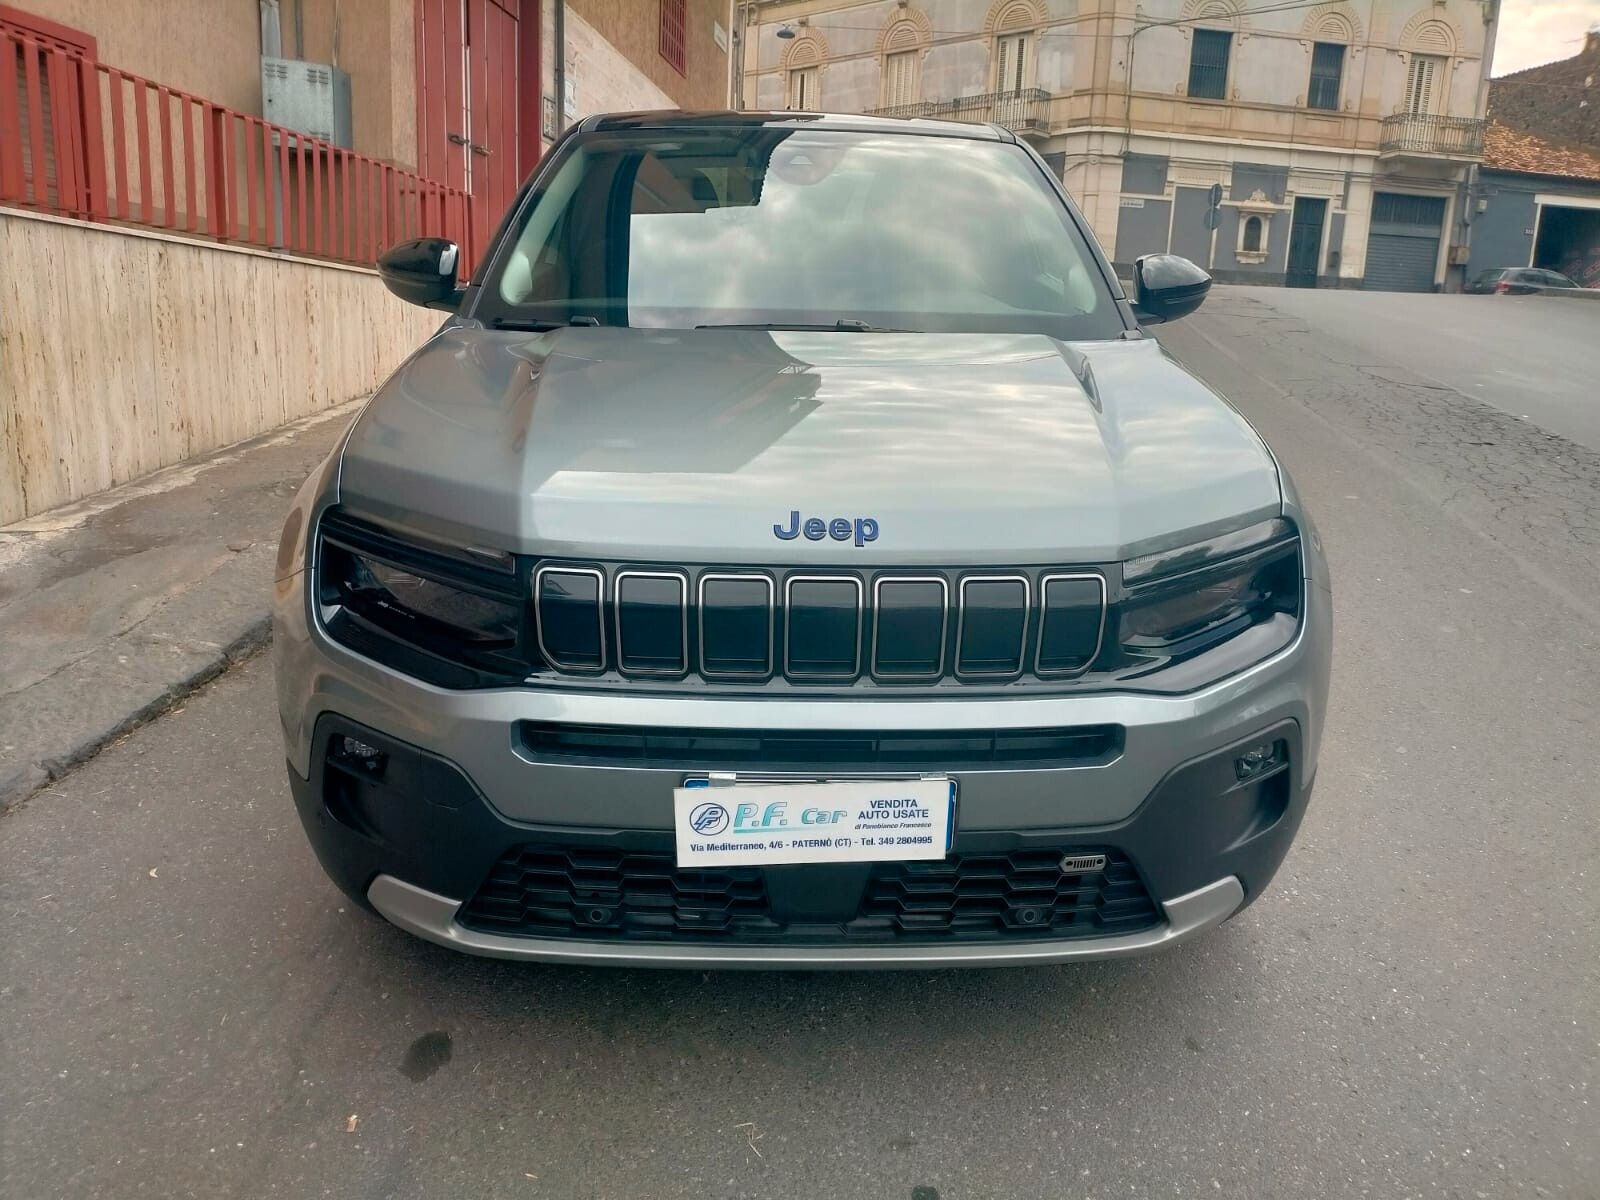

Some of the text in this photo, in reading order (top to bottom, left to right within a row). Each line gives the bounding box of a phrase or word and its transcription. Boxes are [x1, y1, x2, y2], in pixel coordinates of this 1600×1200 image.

[773, 510, 880, 547] Jeep
[869, 800, 918, 809] VENDITA
[734, 801, 848, 828] P.F. Car
[858, 809, 929, 819] AUTO USATE
[690, 843, 704, 852] Via
[769, 841, 783, 849] 4/6
[835, 839, 852, 848] (CT)
[861, 837, 876, 846] Tel.
[878, 836, 894, 845] 349
[896, 835, 933, 845] 2804995
